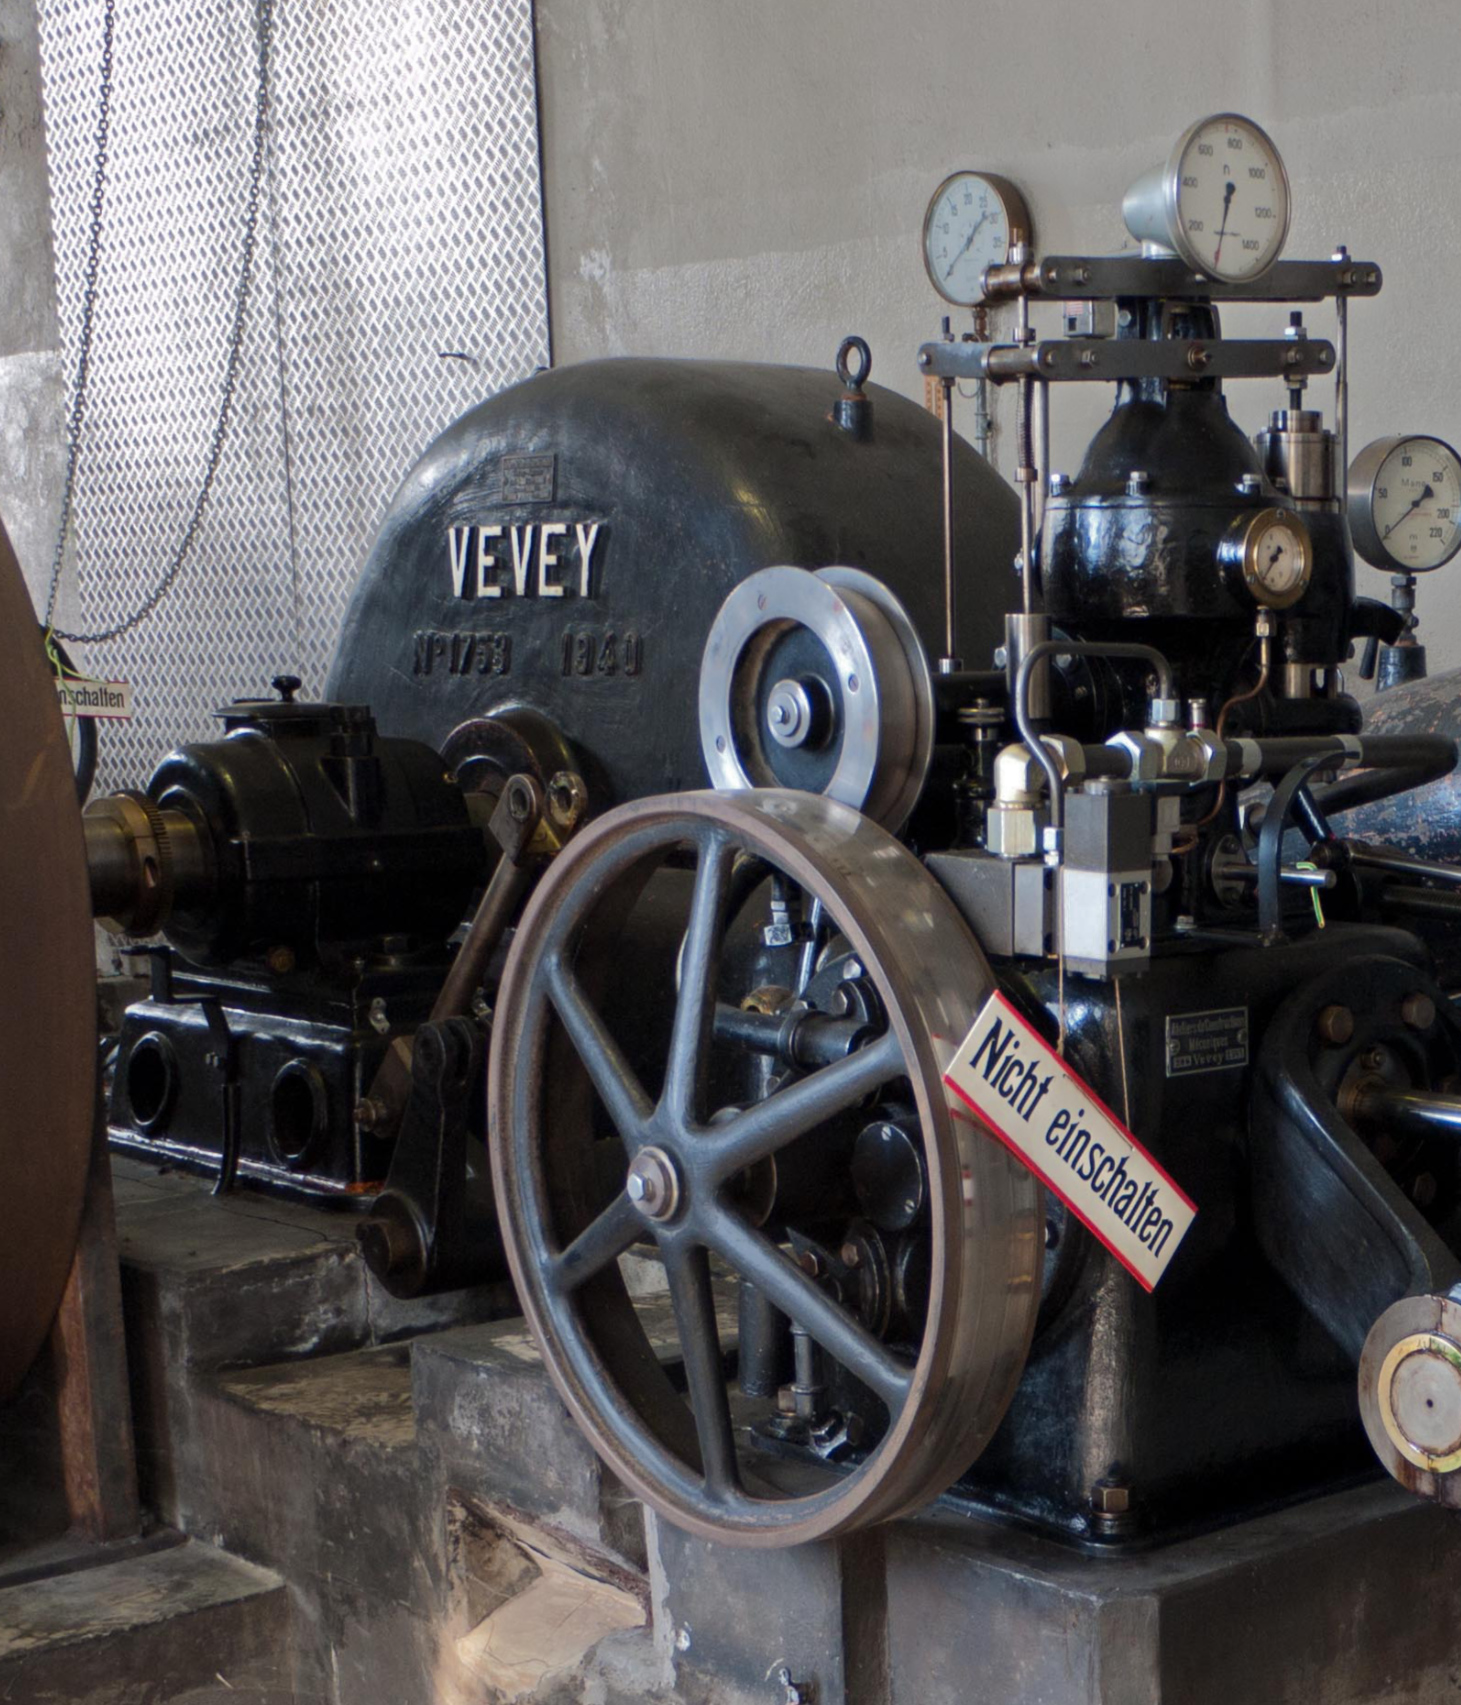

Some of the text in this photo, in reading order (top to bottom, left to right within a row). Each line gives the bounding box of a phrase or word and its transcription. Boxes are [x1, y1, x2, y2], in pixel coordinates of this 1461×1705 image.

[1228, 138, 1242, 150] 800
[1249, 167, 1266, 180] 1000
[1182, 177, 1199, 189] 400
[1254, 207, 1272, 220] 1200
[1189, 220, 1203, 231] 200
[1242, 239, 1260, 251] 1400
[1402, 456, 1412, 467] 100
[1433, 472, 1443, 482] 150
[1379, 488, 1387, 498] 50
[1438, 508, 1449, 519] 200
[1430, 528, 1442, 538] 220
[449, 523, 599, 598] VEVEY
[968, 1016, 1174, 1258] Nicht einschalten
